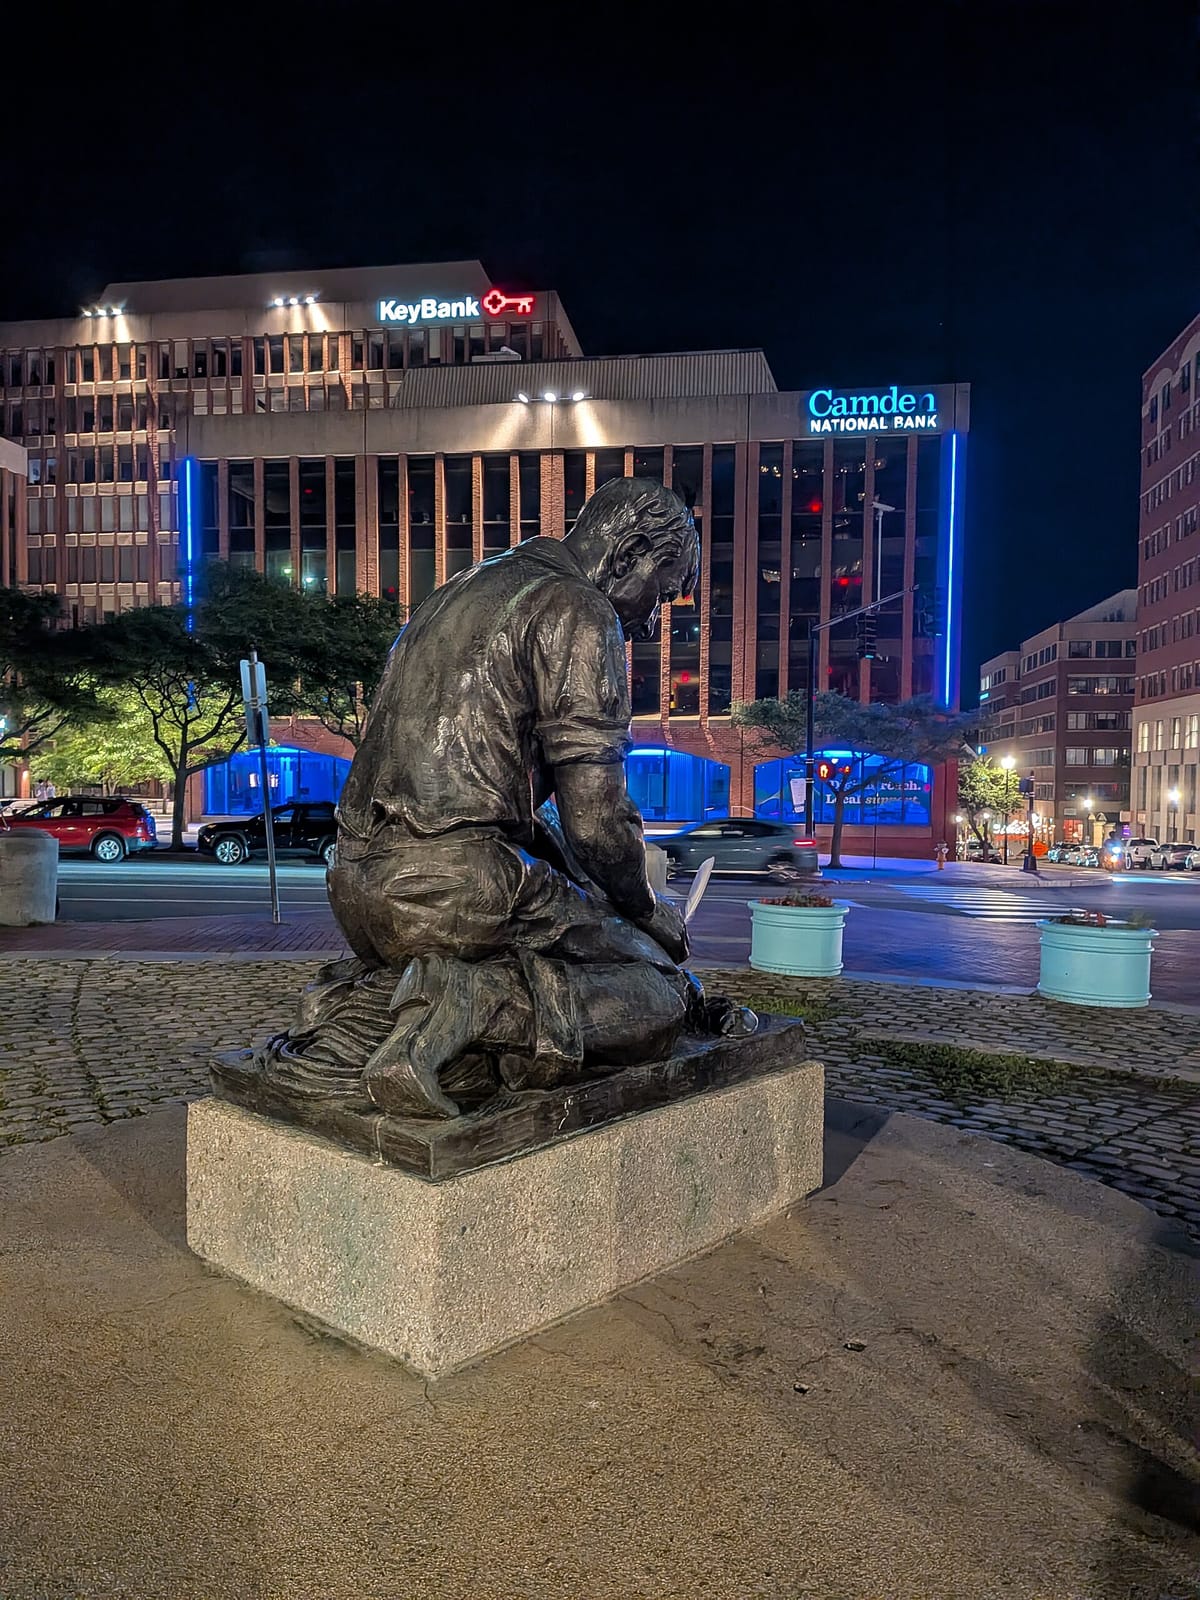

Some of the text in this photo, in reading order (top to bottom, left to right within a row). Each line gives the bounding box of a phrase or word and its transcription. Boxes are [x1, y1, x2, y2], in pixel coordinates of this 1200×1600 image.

[380, 297, 480, 323] KeyBank
[809, 386, 937, 417] Camden
[810, 414, 937, 432] NATIONAL BANK
[825, 794, 861, 804] Lcal
